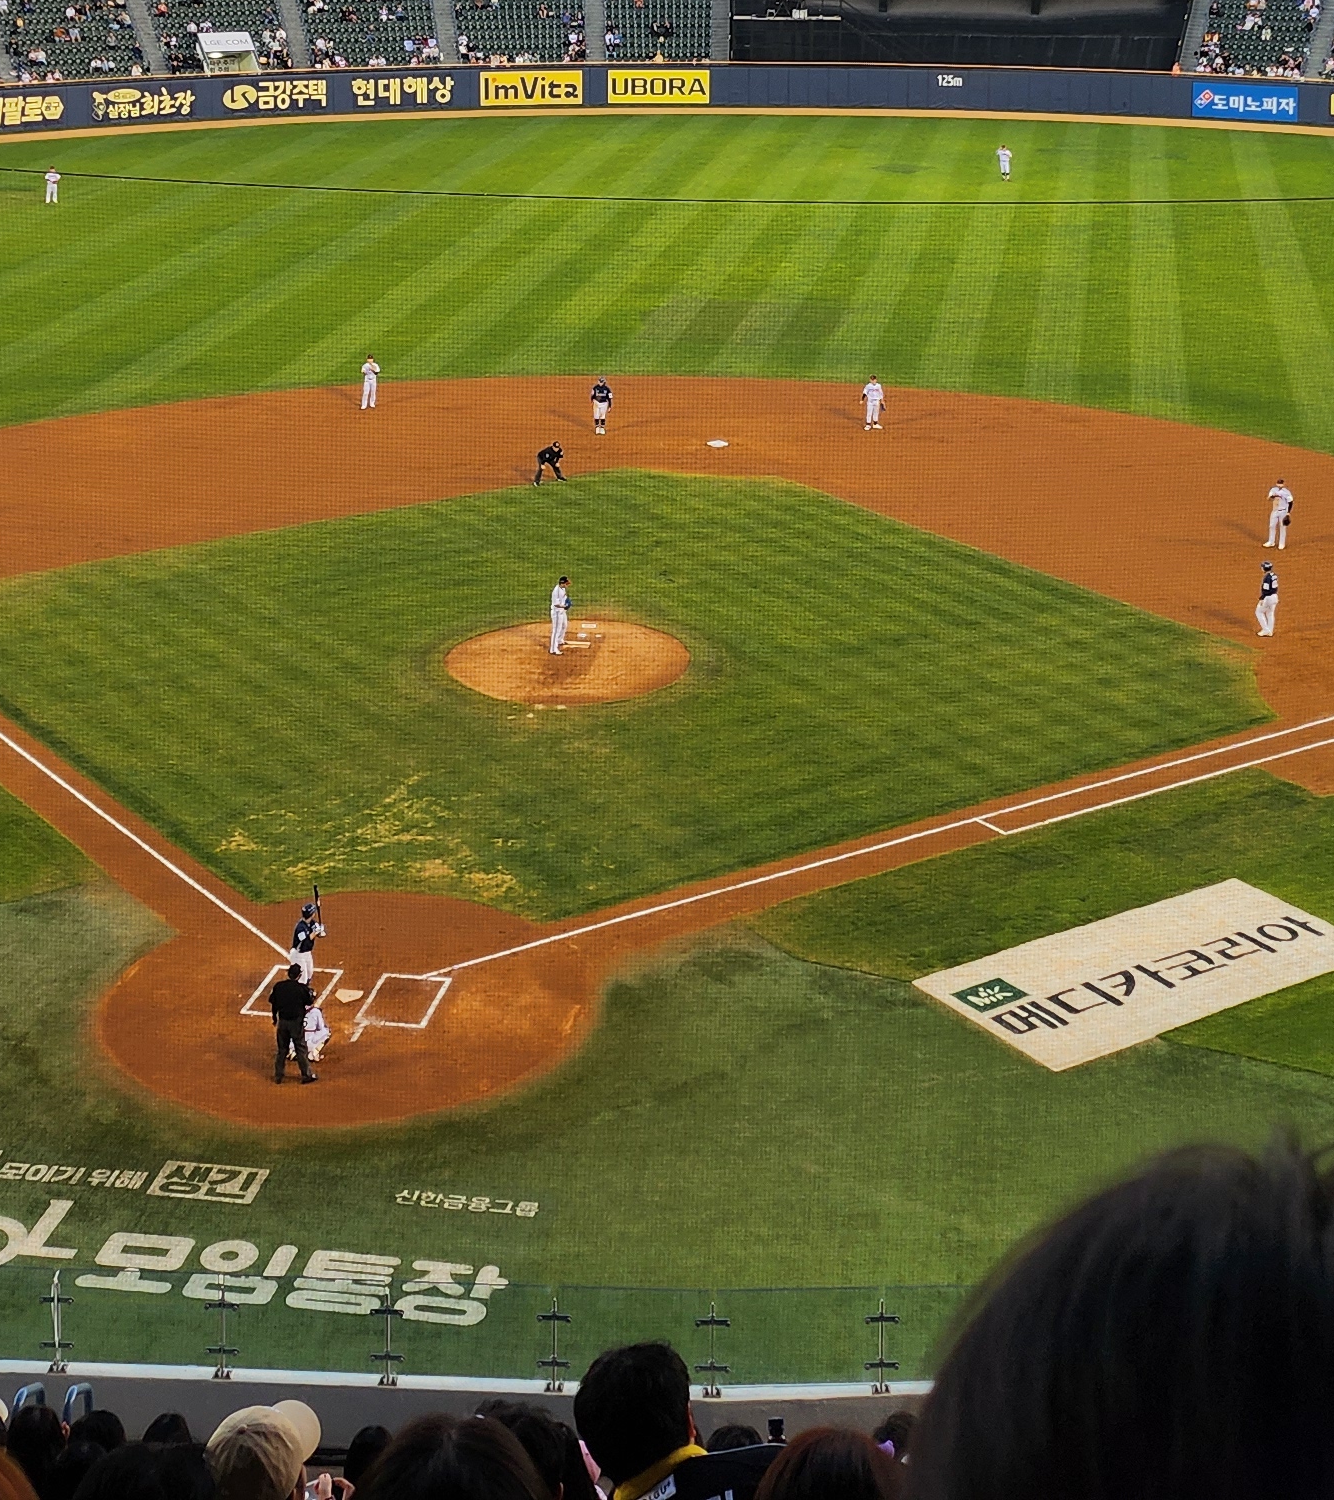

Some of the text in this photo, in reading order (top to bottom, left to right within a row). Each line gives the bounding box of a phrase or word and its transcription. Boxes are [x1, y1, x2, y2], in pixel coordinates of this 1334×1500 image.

[204, 38, 250, 48] LGE.COM
[257, 80, 327, 109] 금강주택
[352, 76, 455, 106] 현대해상
[611, 77, 707, 96] UBORA
[937, 75, 963, 87] 125m
[106, 87, 195, 119] 실장님 회초장
[1212, 94, 1296, 115] 도미노피자
[989, 915, 1325, 1036] 메디카코리아
[87, 1167, 149, 1191] 위해
[394, 1188, 540, 1218] 신한금융그룹
[74, 1231, 511, 1326] 모임통장
